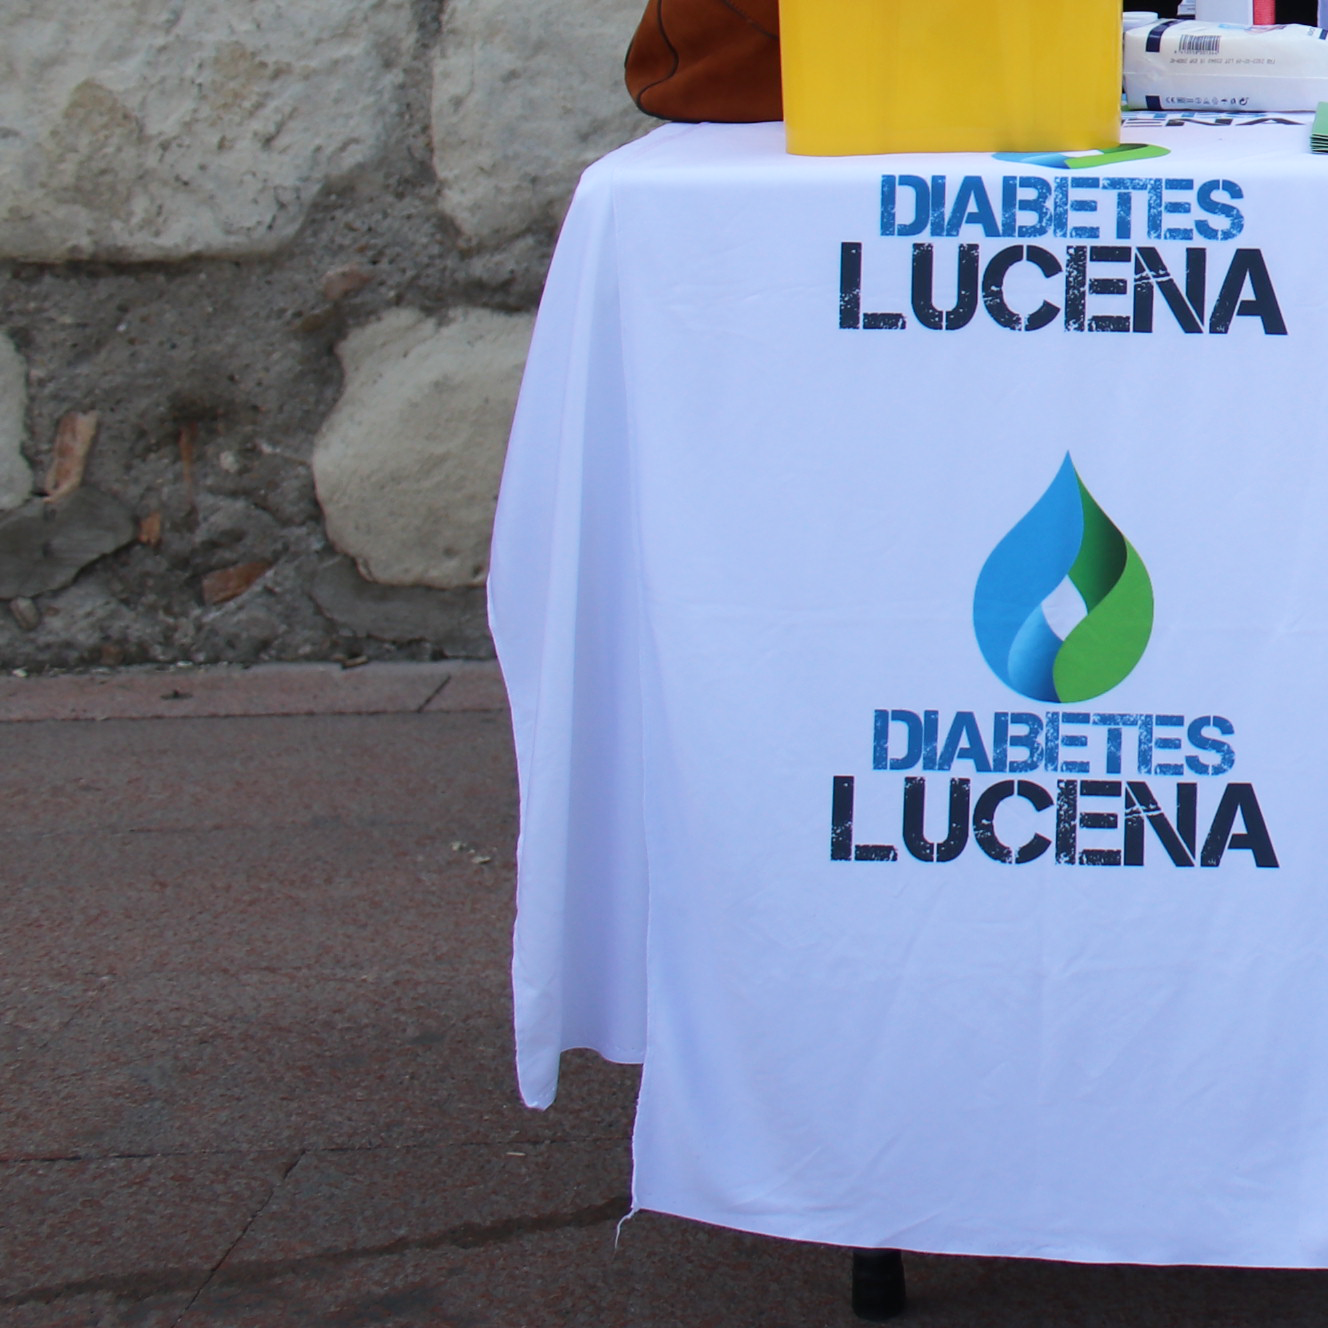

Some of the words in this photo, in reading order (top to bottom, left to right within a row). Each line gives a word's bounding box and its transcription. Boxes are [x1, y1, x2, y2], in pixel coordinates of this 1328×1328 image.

[880, 174, 1245, 240] DIABETES
[839, 242, 1288, 336] LUCENA
[873, 709, 1236, 776] DIABETES
[830, 775, 1280, 868] LUCENA
